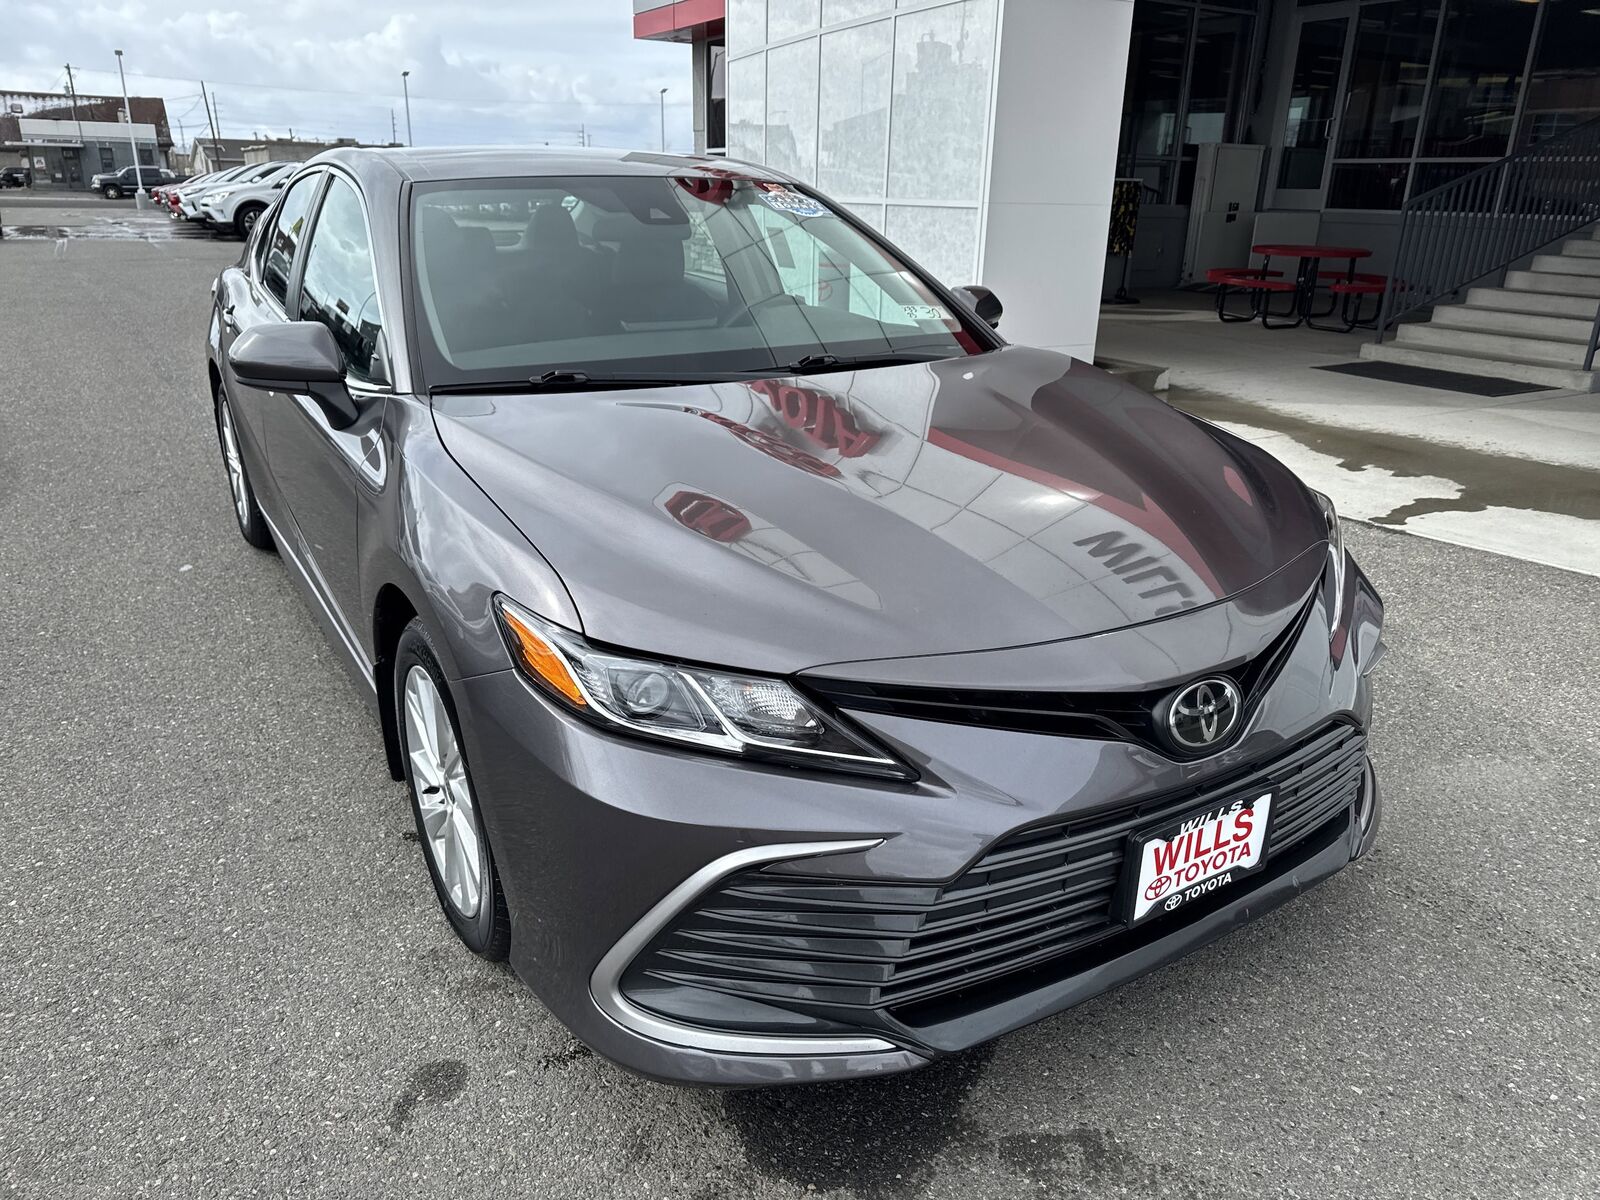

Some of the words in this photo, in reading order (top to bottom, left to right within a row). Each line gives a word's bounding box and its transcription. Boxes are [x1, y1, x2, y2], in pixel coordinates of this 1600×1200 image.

[1179, 799, 1244, 835] WILLS
[1153, 808, 1254, 877] WILLS
[1174, 841, 1251, 887] TOYOTA
[1184, 872, 1232, 901] TOYOTA
